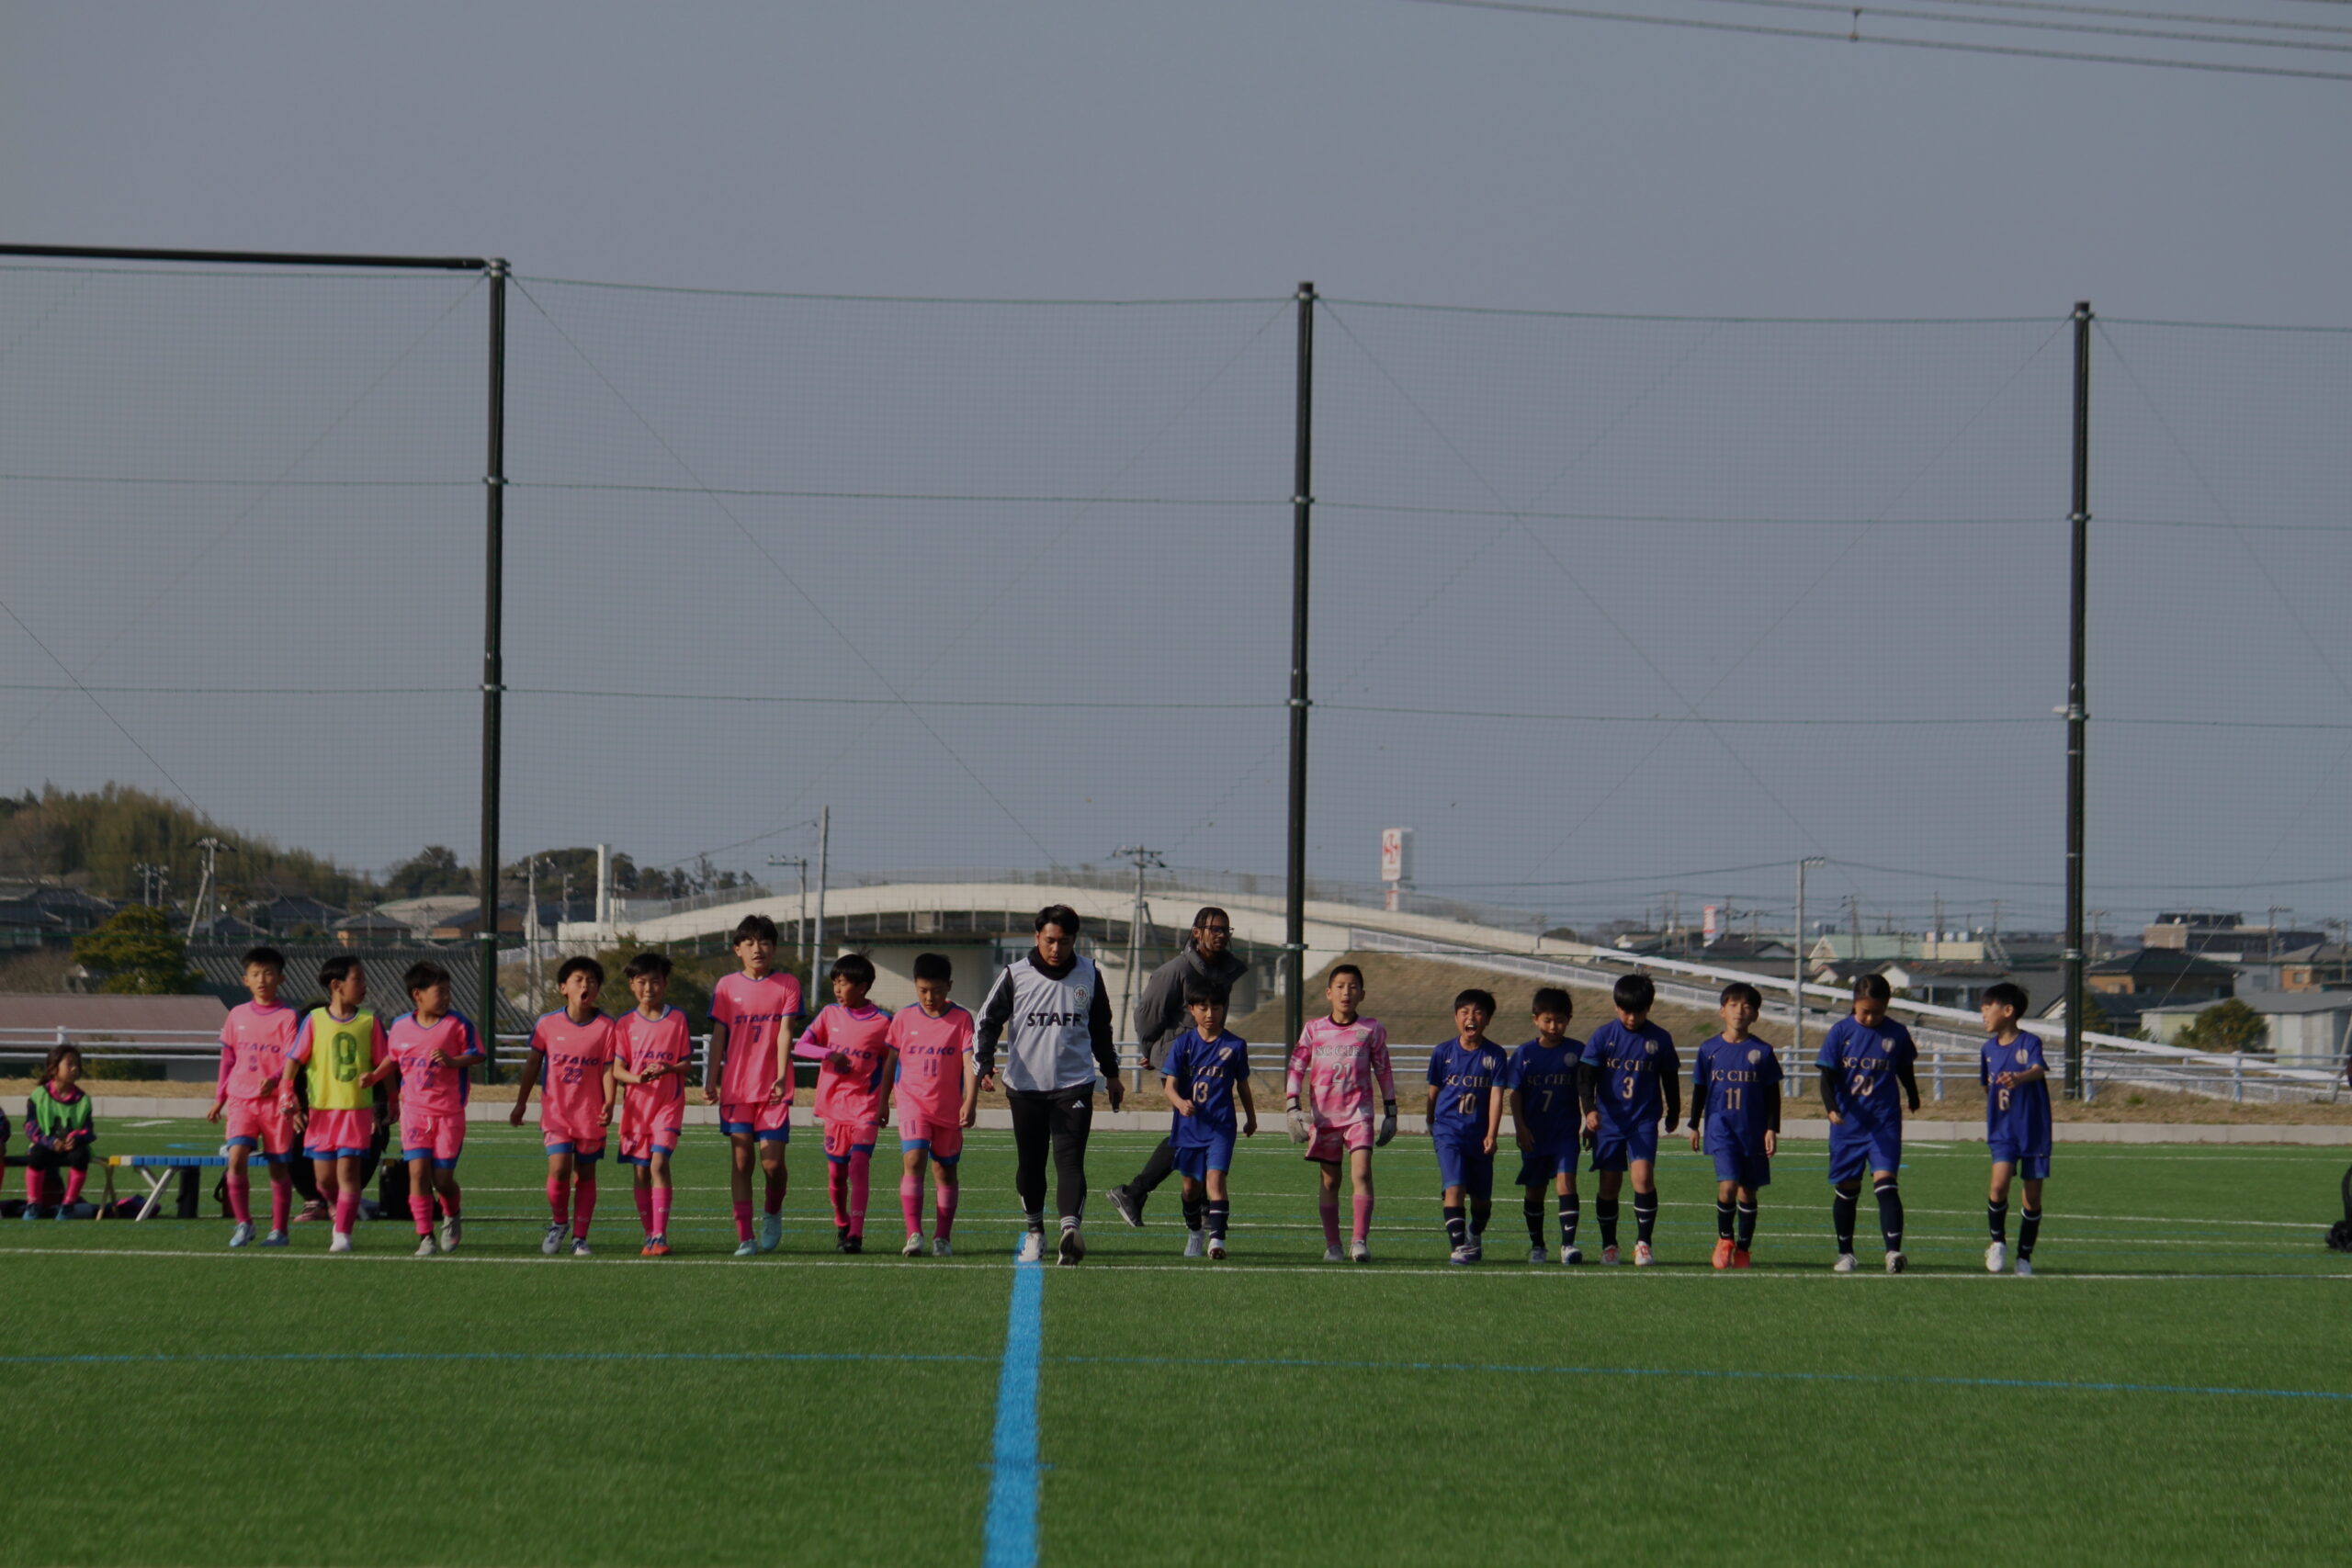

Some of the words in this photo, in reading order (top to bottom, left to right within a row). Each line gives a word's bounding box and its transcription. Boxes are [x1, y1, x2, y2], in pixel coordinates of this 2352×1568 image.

[1027, 1012, 1081, 1026] STAFF
[752, 1026, 762, 1043] 7
[333, 1032, 357, 1082] 9
[1841, 1057, 1858, 1068] SC
[562, 1066, 583, 1084] 22
[1331, 1063, 1353, 1083] 21
[1727, 1070, 1759, 1082] CIEL
[1193, 1081, 1209, 1103] 13
[1622, 1076, 1634, 1099] 3
[1851, 1074, 1874, 1096] 20
[1458, 1093, 1476, 1114] 10
[1542, 1090, 1554, 1112] 7
[1725, 1088, 1741, 1110] 11
[1998, 1089, 2010, 1111] 6
